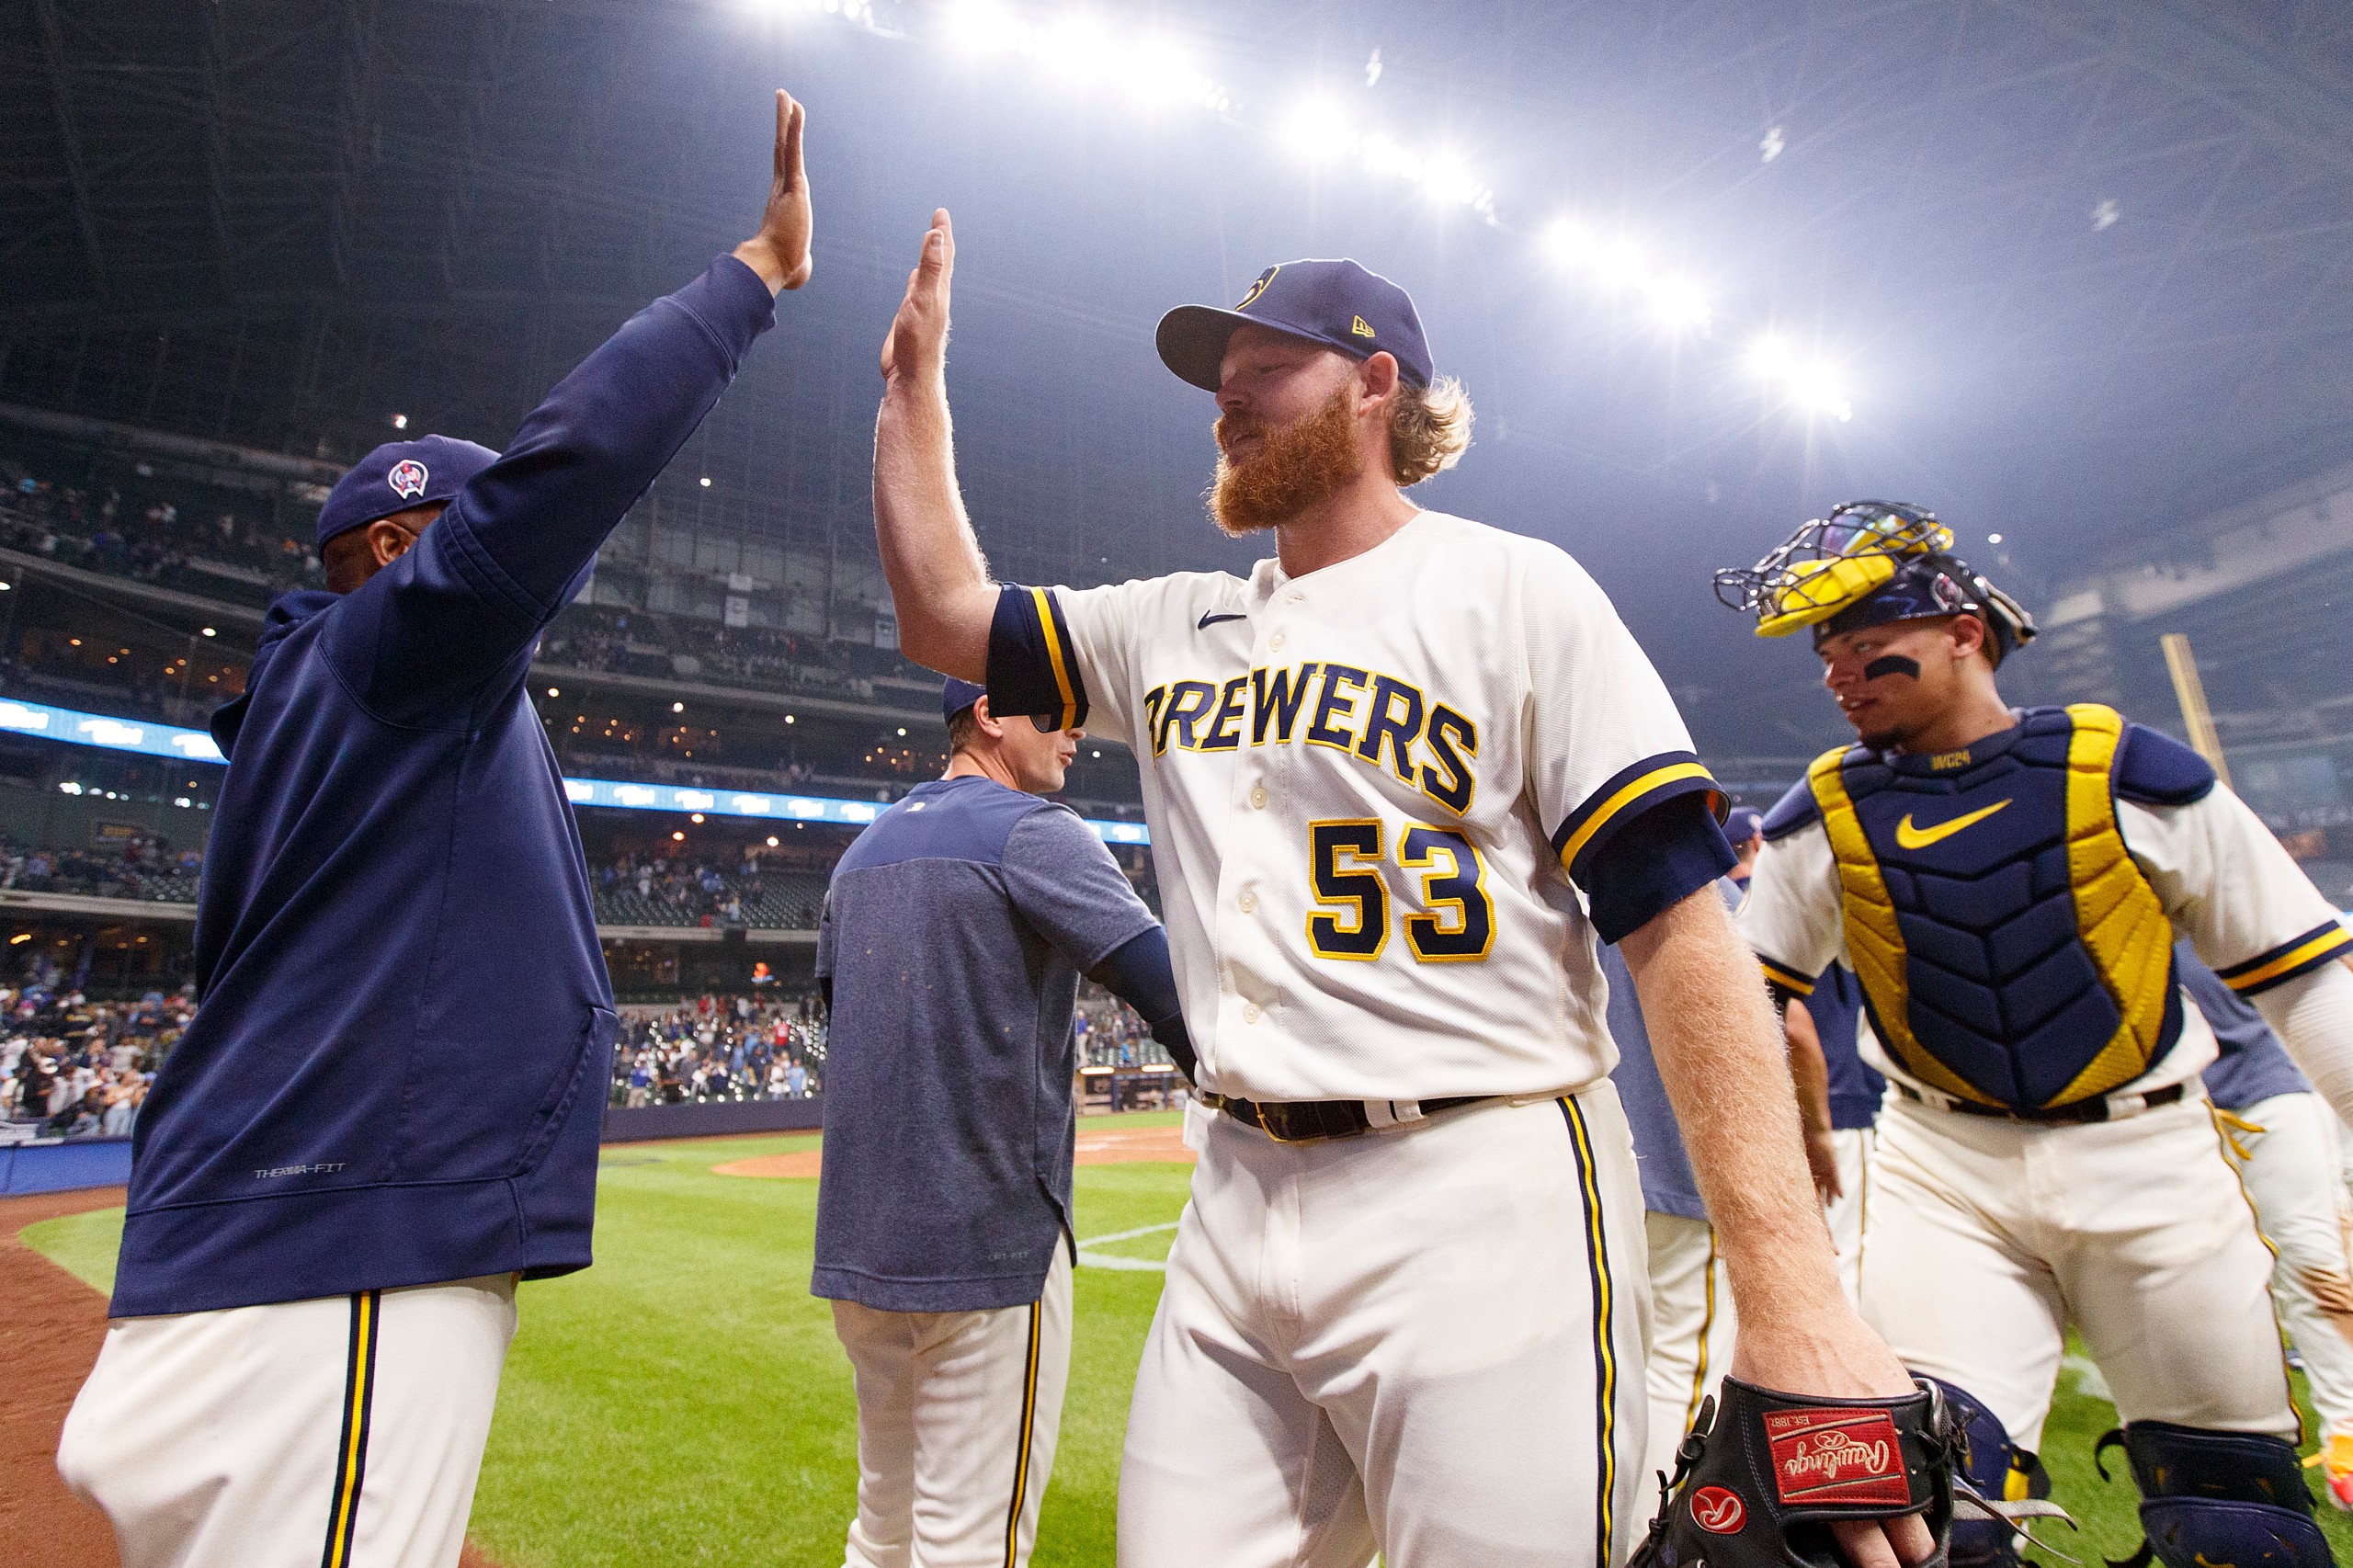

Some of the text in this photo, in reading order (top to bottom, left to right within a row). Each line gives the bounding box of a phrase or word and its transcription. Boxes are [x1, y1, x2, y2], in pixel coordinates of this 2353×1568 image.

[1305, 817, 1497, 963] 53
[255, 1163, 346, 1179] THERMA-FIT
[1785, 1440, 1889, 1479] Rawlings
